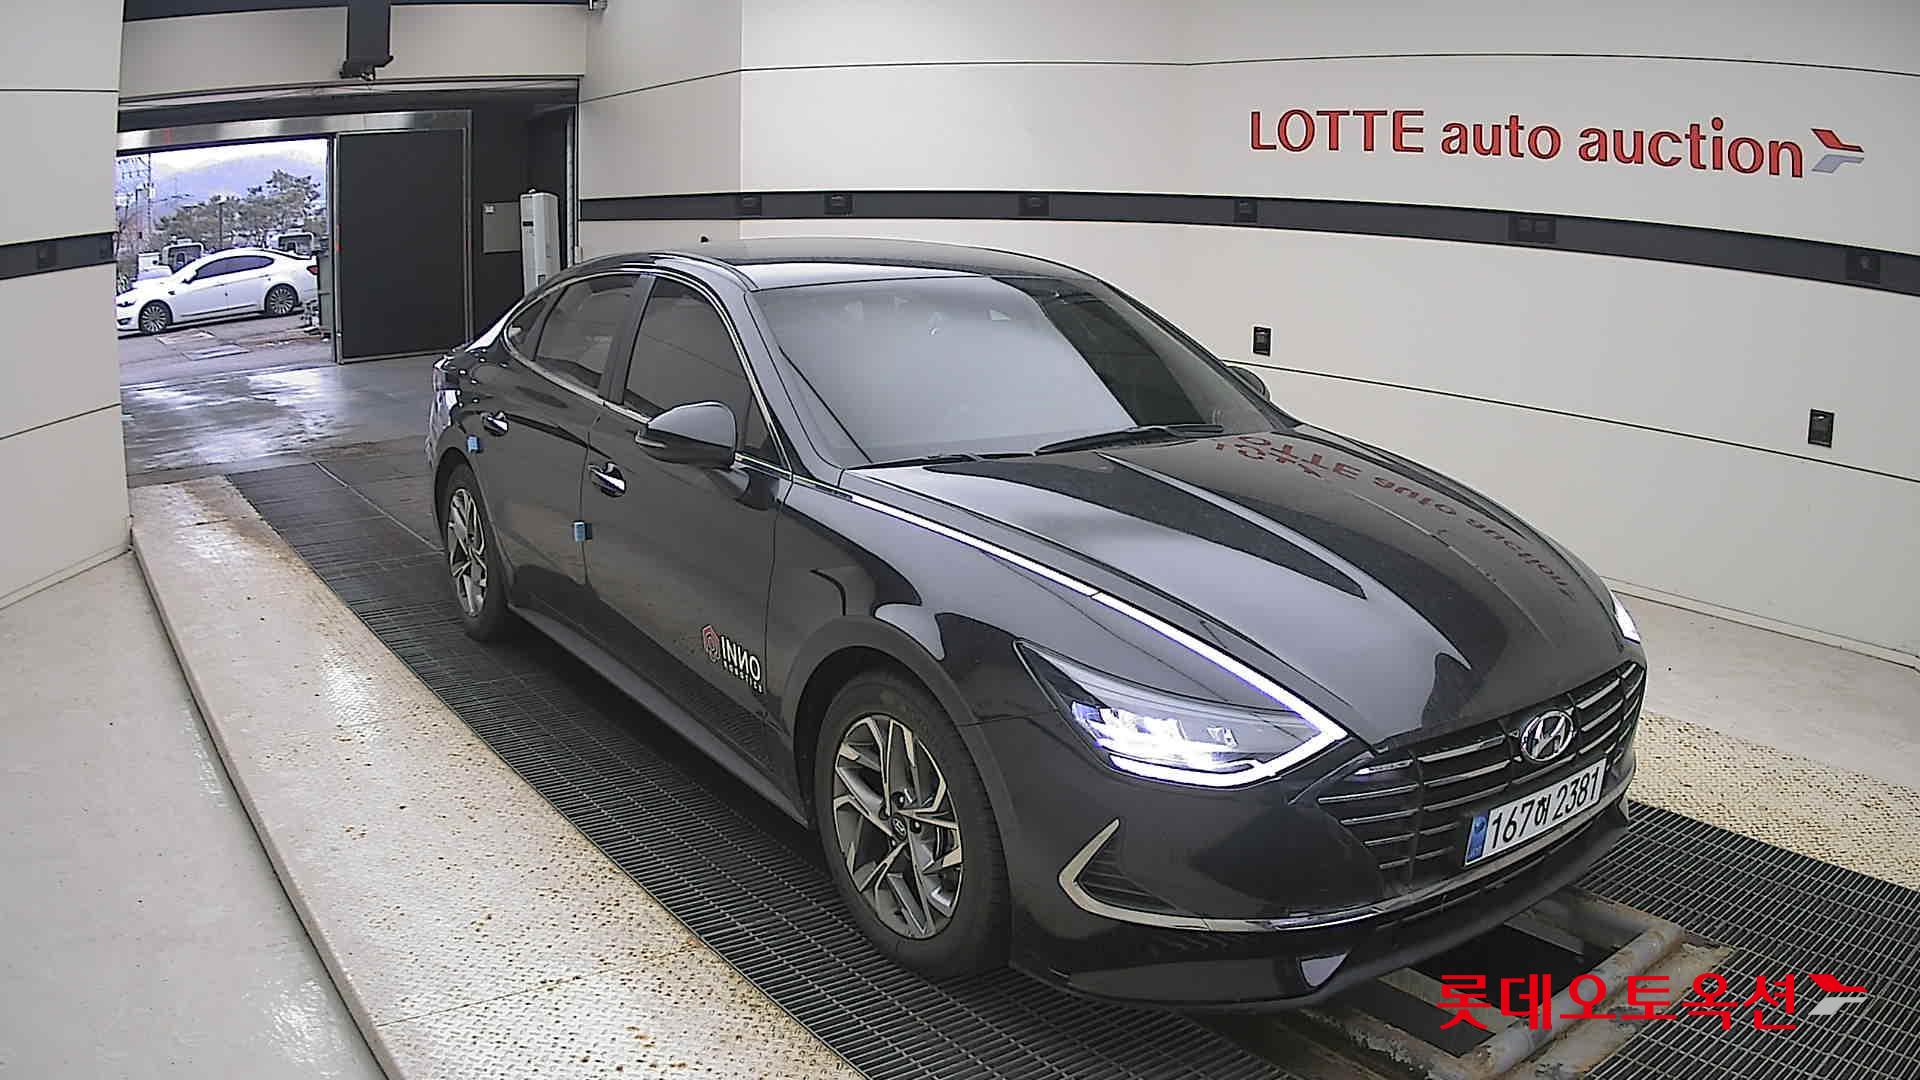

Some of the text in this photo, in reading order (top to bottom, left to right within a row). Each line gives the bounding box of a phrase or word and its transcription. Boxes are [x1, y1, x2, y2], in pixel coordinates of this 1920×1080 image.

[1249, 109, 1804, 178] LOTTE auto auction
[1552, 766, 1600, 821] 2381
